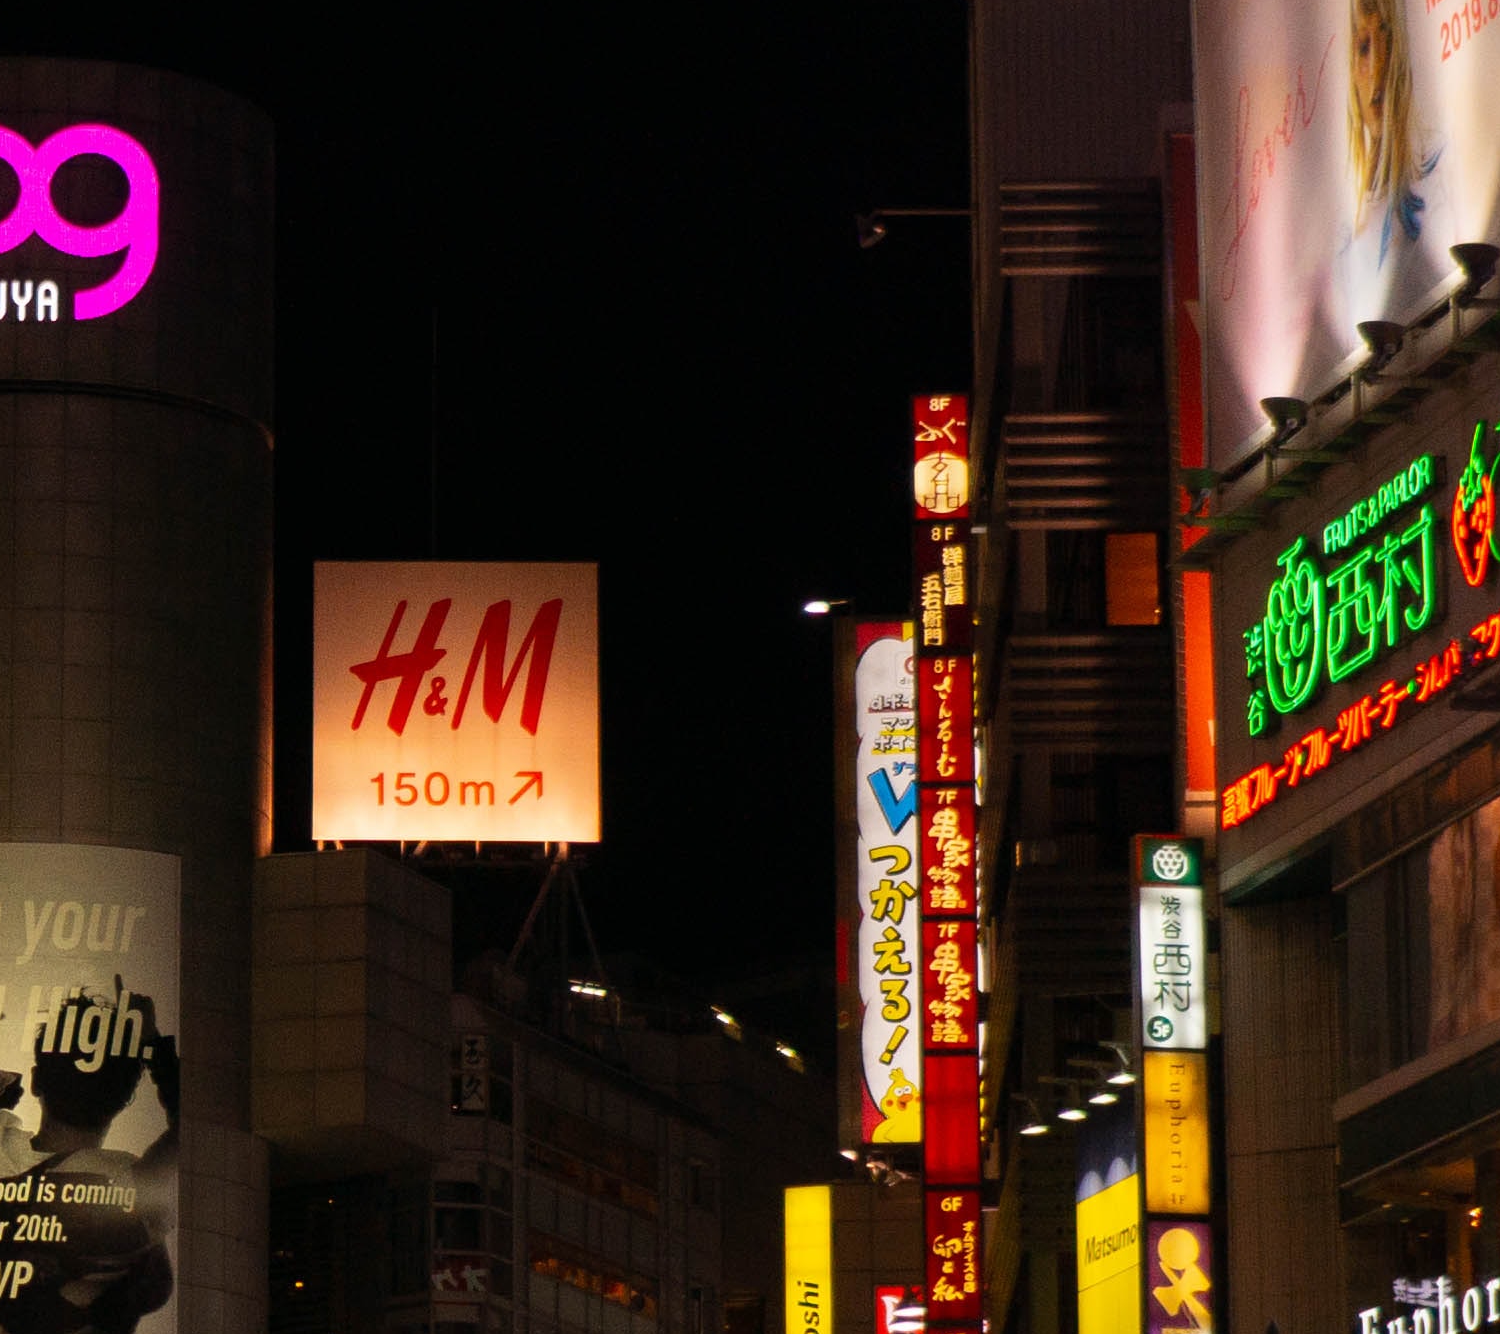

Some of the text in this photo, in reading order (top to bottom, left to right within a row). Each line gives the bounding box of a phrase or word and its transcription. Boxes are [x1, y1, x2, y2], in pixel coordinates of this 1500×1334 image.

[929, 397, 951, 412] 8F
[348, 596, 563, 738] H&M
[1243, 622, 1269, 737] 渋谷
[936, 791, 957, 805] 7F
[928, 810, 970, 909] 串家物語
[15, 899, 147, 966] your
[938, 924, 959, 938] 7F
[929, 943, 972, 1043] 串家物語
[19, 985, 155, 1074] High.
[1151, 1020, 1170, 1039] 5F
[37, 1176, 56, 1204] is
[60, 1178, 138, 1213] coming
[941, 1197, 963, 1212] 6F
[13, 1214, 68, 1243] 20th.
